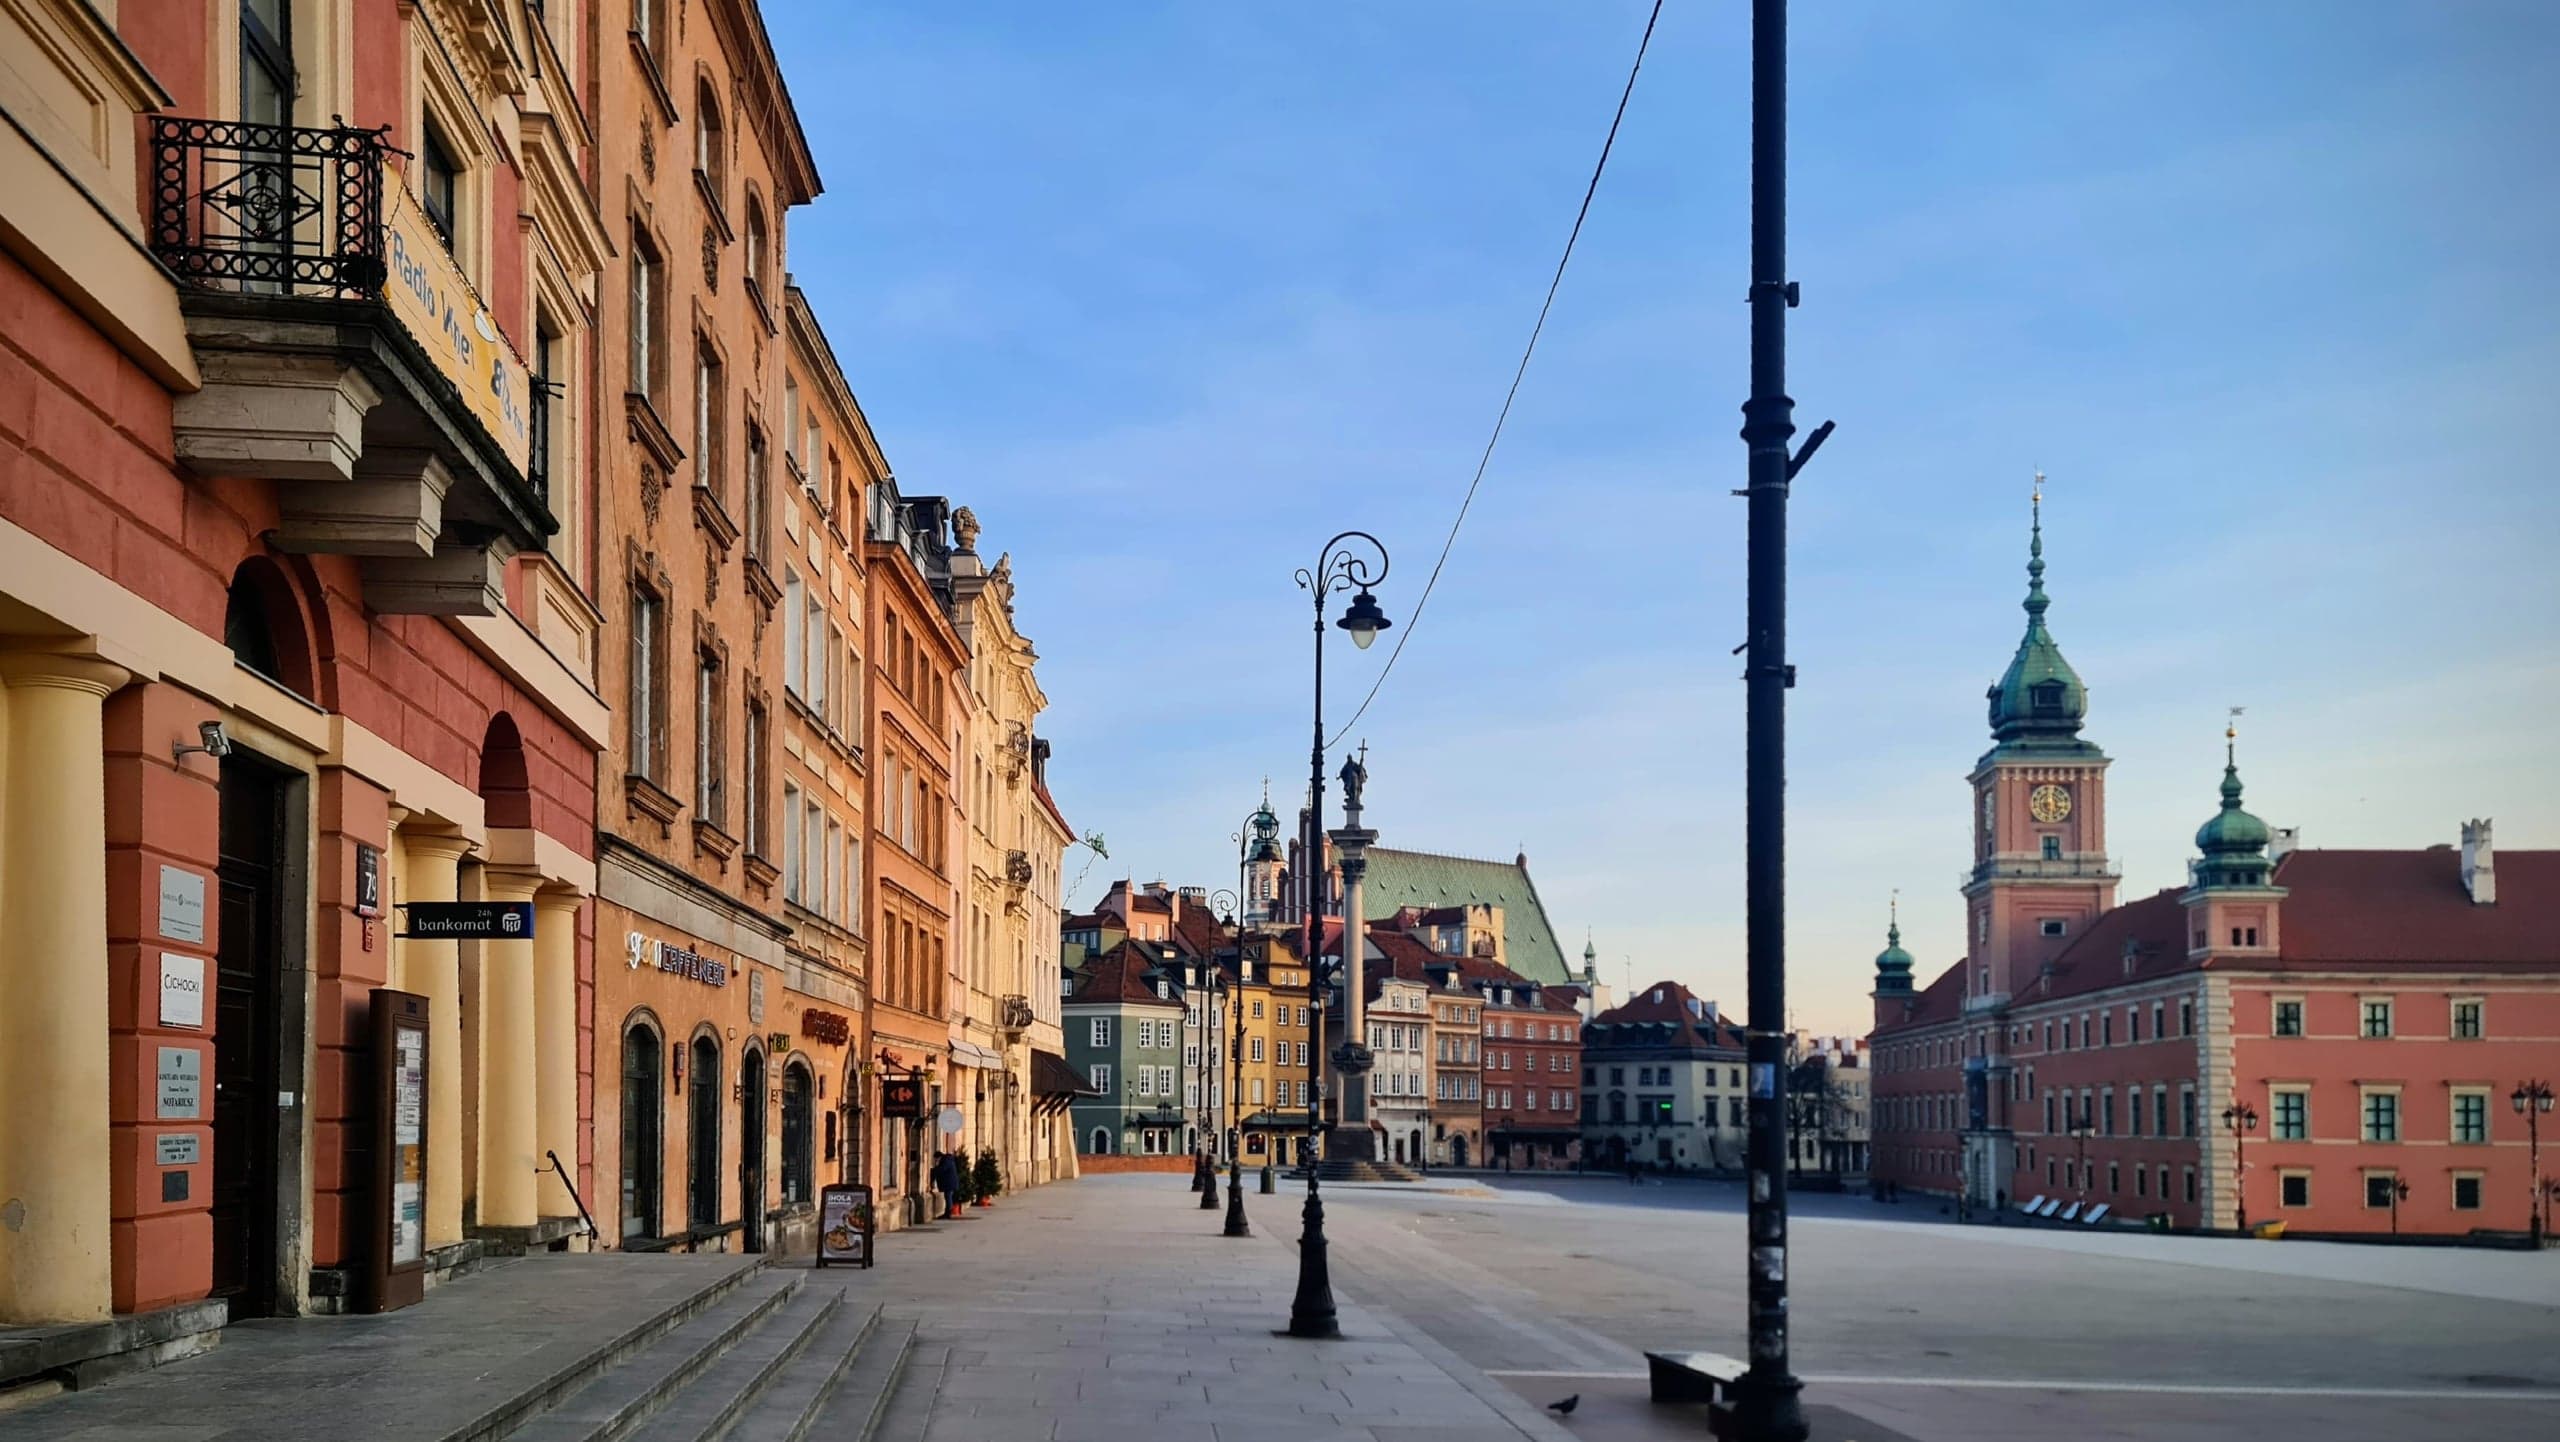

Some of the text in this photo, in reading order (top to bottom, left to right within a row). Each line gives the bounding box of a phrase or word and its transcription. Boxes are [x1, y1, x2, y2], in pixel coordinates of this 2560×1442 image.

[392, 230, 436, 318] Radio
[365, 871, 376, 901] 79
[418, 917, 492, 931] bankomat
[477, 909, 492, 918] 24h
